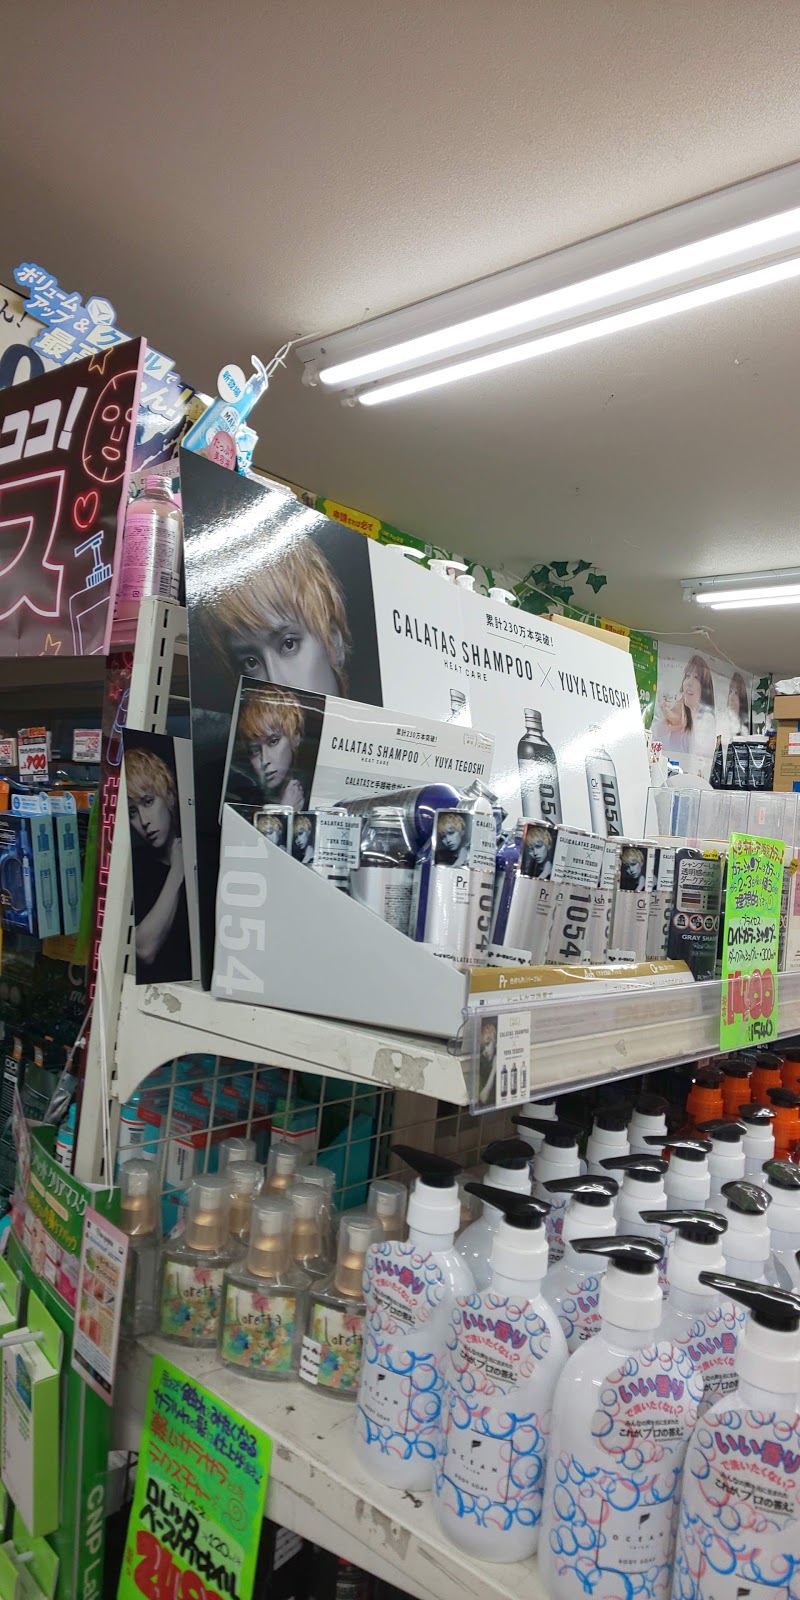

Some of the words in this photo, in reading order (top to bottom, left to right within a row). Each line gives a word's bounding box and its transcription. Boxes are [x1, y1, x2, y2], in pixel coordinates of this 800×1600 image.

[17, 264, 83, 312] ボリューム
[27, 294, 74, 324] アップ
[222, 370, 242, 398] 新登場
[486, 613, 554, 647] 累計230万本突破!
[392, 609, 456, 658] CALATAS
[461, 641, 533, 681] SHAMPOO
[557, 670, 588, 698] YUYA
[589, 681, 630, 709] TEGOSHI
[444, 659, 462, 674] HEAT
[465, 668, 488, 682] CARE
[331, 736, 373, 756] CALATAS
[377, 745, 419, 763] SHAMPOO
[434, 755, 453, 770] YUYA
[454, 759, 485, 775] TEGOSHI
[601, 780, 620, 837] 1054
[456, 875, 468, 889] Pr
[540, 888, 550, 900] Pr
[214, 838, 269, 995] 1054
[559, 893, 592, 959] 1054
[499, 974, 508, 988] Pr
[374, 1256, 426, 1296] いい香り
[235, 1294, 282, 1326] Loretta
[462, 1310, 527, 1349] いい香り
[464, 1333, 521, 1362] で洗いたくない?
[687, 1332, 738, 1362] いい香
[618, 1374, 685, 1405] いい香り
[625, 1400, 685, 1418] で洗いたくない?
[450, 1448, 498, 1474] OCEAN
[714, 1430, 800, 1475] いい香り
[720, 1459, 796, 1491] で洗いたくない?
[83, 1484, 105, 1555] CNP
